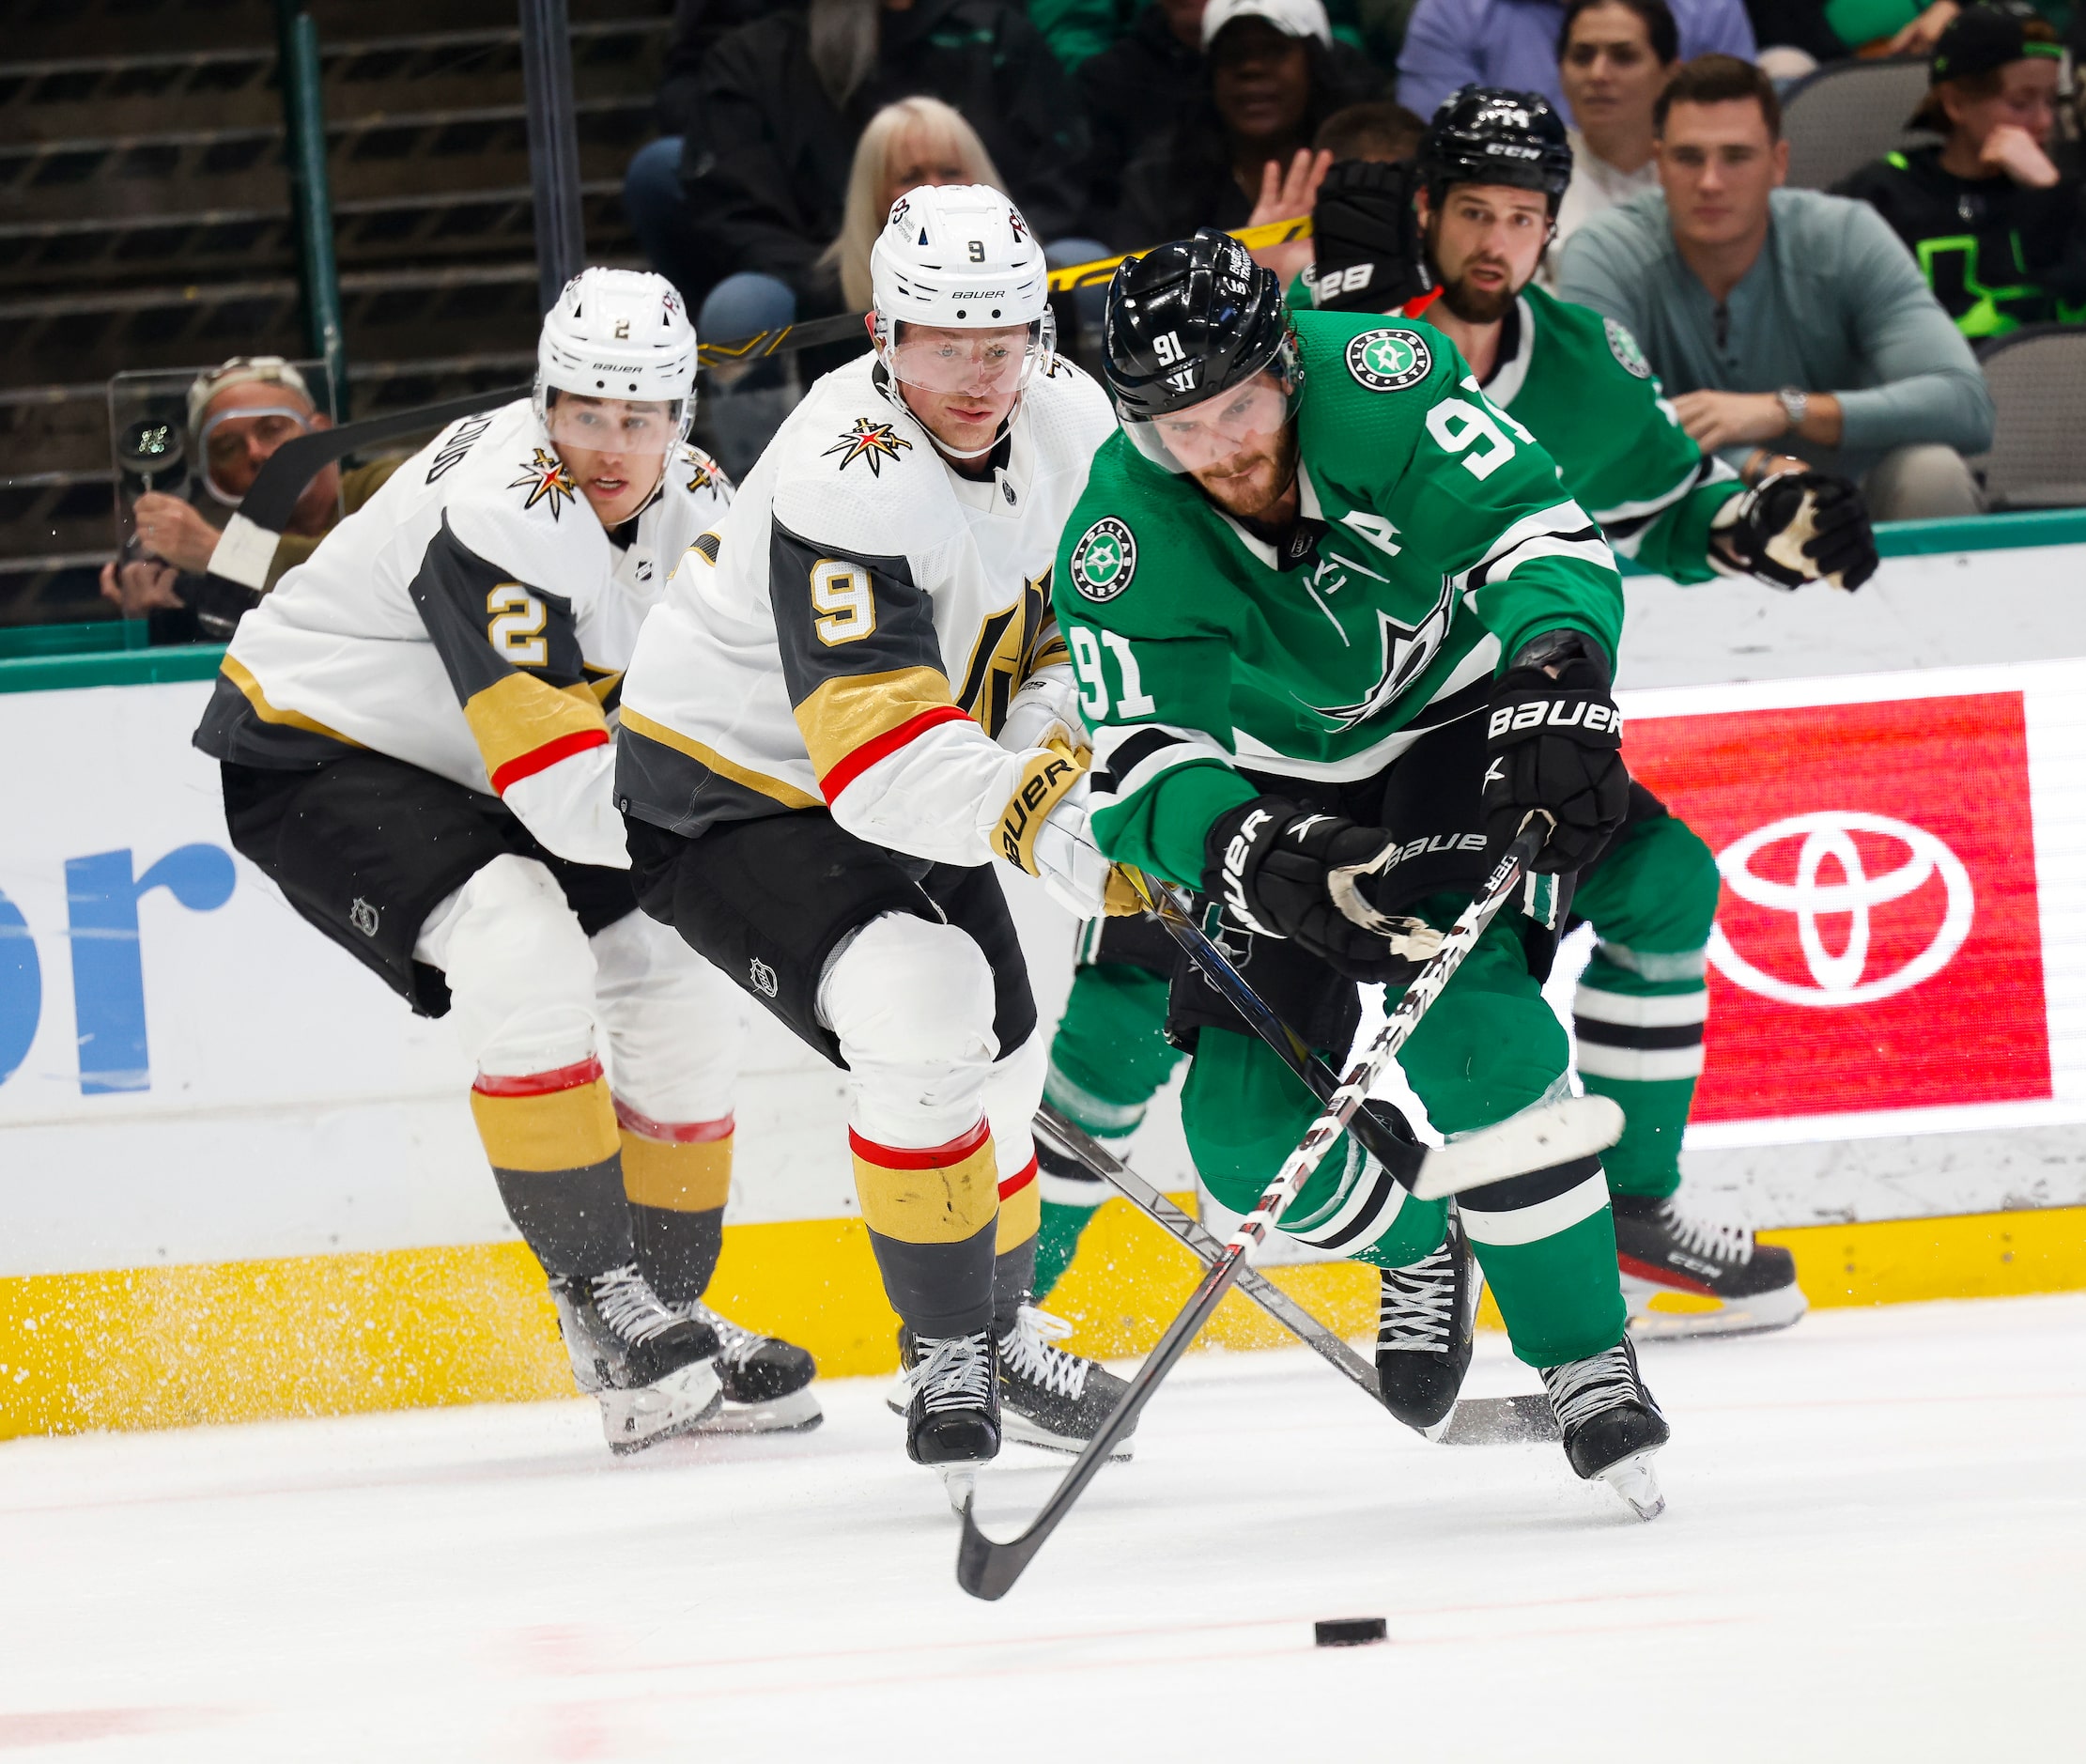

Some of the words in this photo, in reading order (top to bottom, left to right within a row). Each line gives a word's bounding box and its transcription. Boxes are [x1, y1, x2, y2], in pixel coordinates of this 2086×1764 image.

[1485, 143, 1542, 161] CCM
[967, 240, 985, 263] 9
[951, 290, 1006, 300] BAUER
[614, 318, 630, 340] 2
[1152, 331, 1186, 367] 91
[593, 363, 643, 374] BAUER
[1352, 332, 1389, 385] DALLAS
[1397, 335, 1428, 385] STARS
[1086, 522, 1132, 568] DALLAS
[1338, 510, 1402, 557] A
[1074, 558, 1119, 597] STARS
[487, 582, 549, 667] 2
[810, 558, 877, 648] 9
[1069, 627, 1157, 721] 91
[1488, 700, 1624, 741] BAUER
[1383, 832, 1488, 877] BAUE
